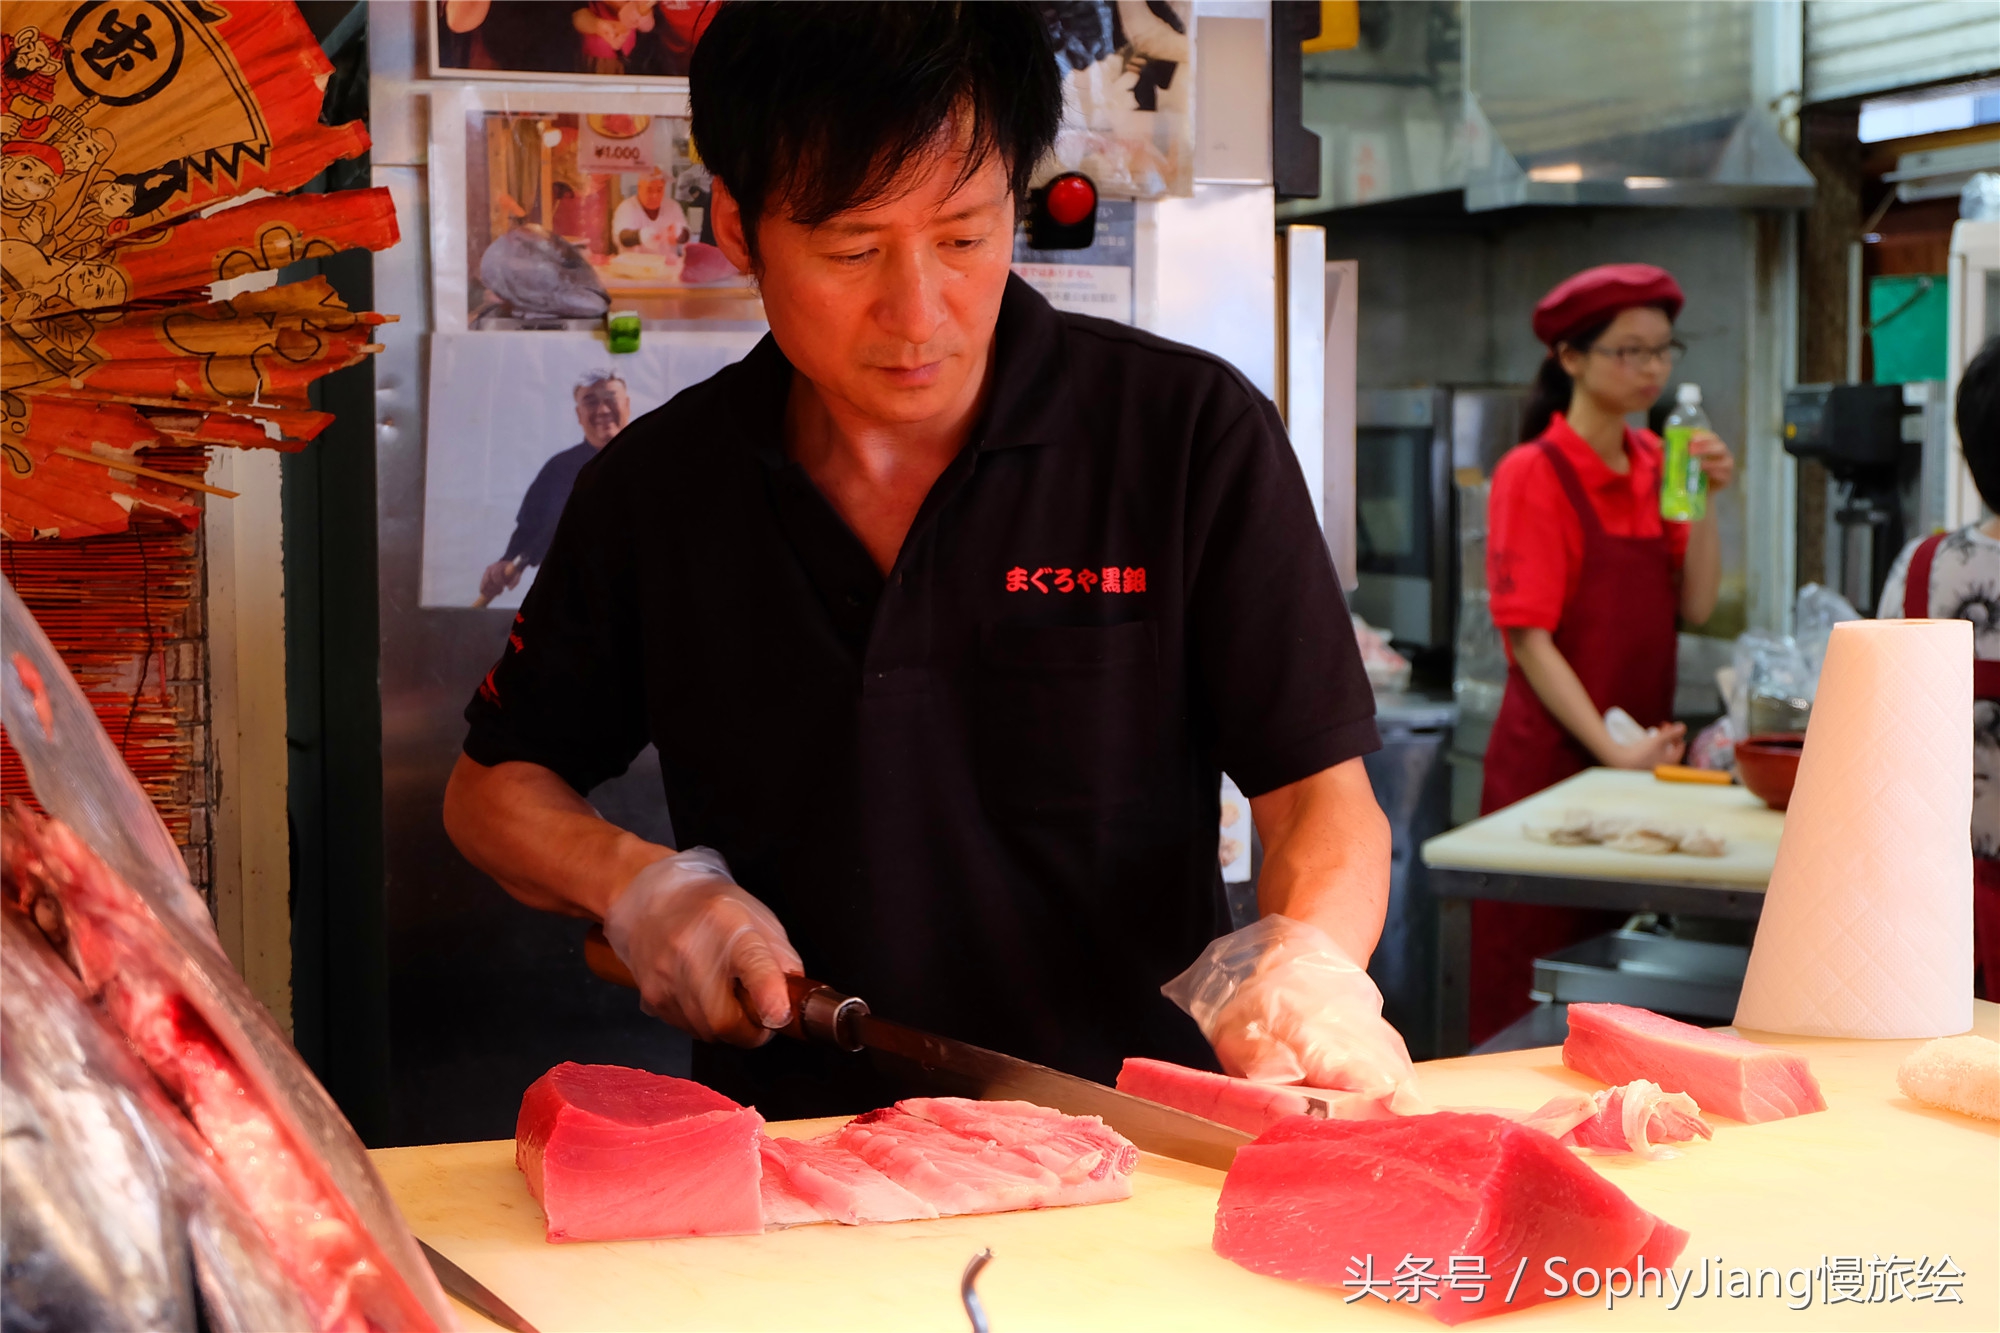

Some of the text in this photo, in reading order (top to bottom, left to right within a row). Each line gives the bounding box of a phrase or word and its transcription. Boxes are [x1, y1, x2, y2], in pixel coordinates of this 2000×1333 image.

[1006, 566, 1147, 594] まぐろや黒銀
